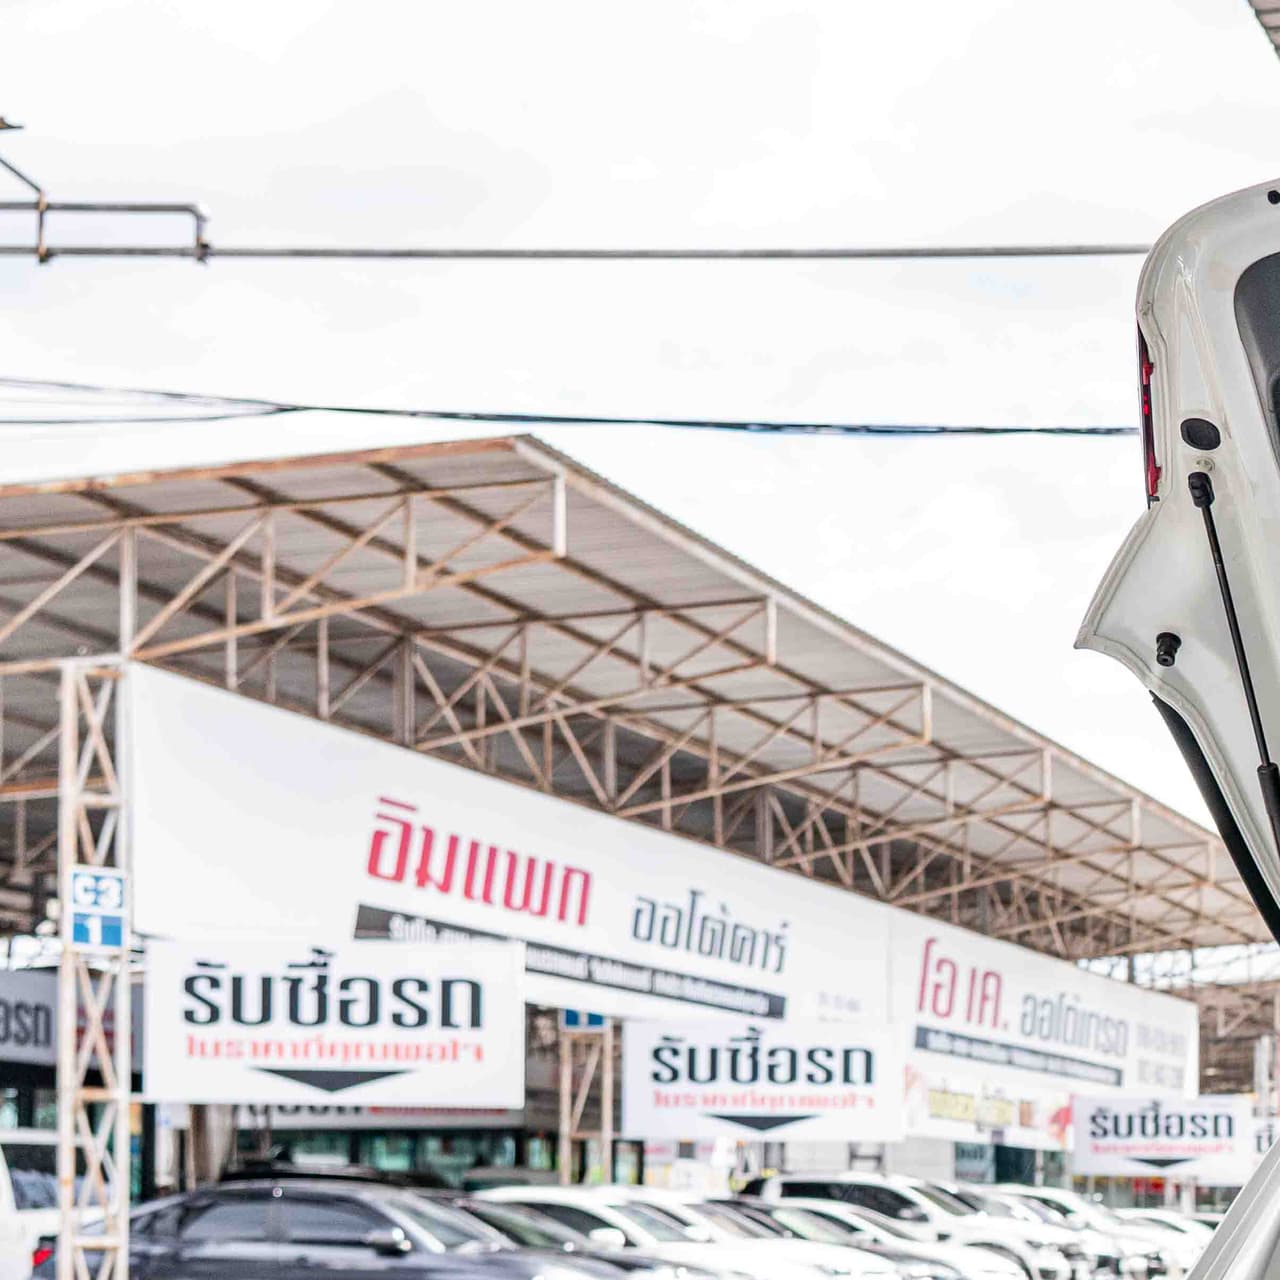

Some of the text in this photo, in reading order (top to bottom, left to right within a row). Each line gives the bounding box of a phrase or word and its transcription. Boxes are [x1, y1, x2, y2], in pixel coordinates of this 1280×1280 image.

[86, 916, 102, 945] 1
[184, 948, 483, 1028] รับซื้อรถ
[651, 1026, 874, 1085] รับซื้อรถ
[1089, 1099, 1234, 1139] รับซื้อรถ
